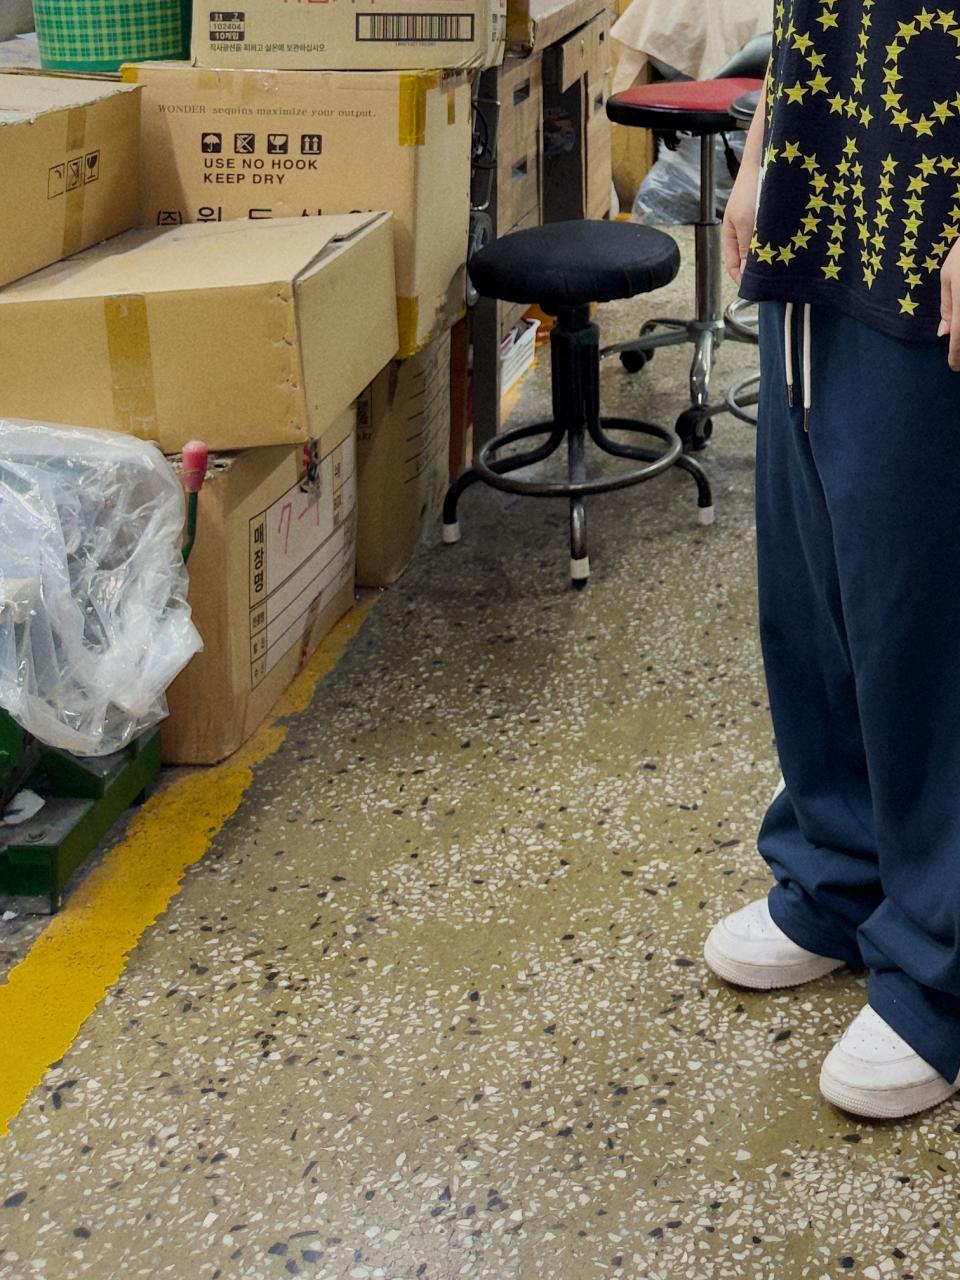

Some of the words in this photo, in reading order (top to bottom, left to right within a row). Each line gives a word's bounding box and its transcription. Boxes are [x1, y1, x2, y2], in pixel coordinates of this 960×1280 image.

[157, 104, 207, 114] WONDER
[212, 107, 253, 117] sequins
[256, 107, 308, 117] maximize
[311, 109, 334, 118] your
[338, 109, 376, 118] output.
[204, 158, 236, 169] USE
[242, 159, 265, 170] NO
[272, 159, 318, 170] HOOK
[204, 173, 246, 184] KEEP
[252, 174, 286, 185] DRY
